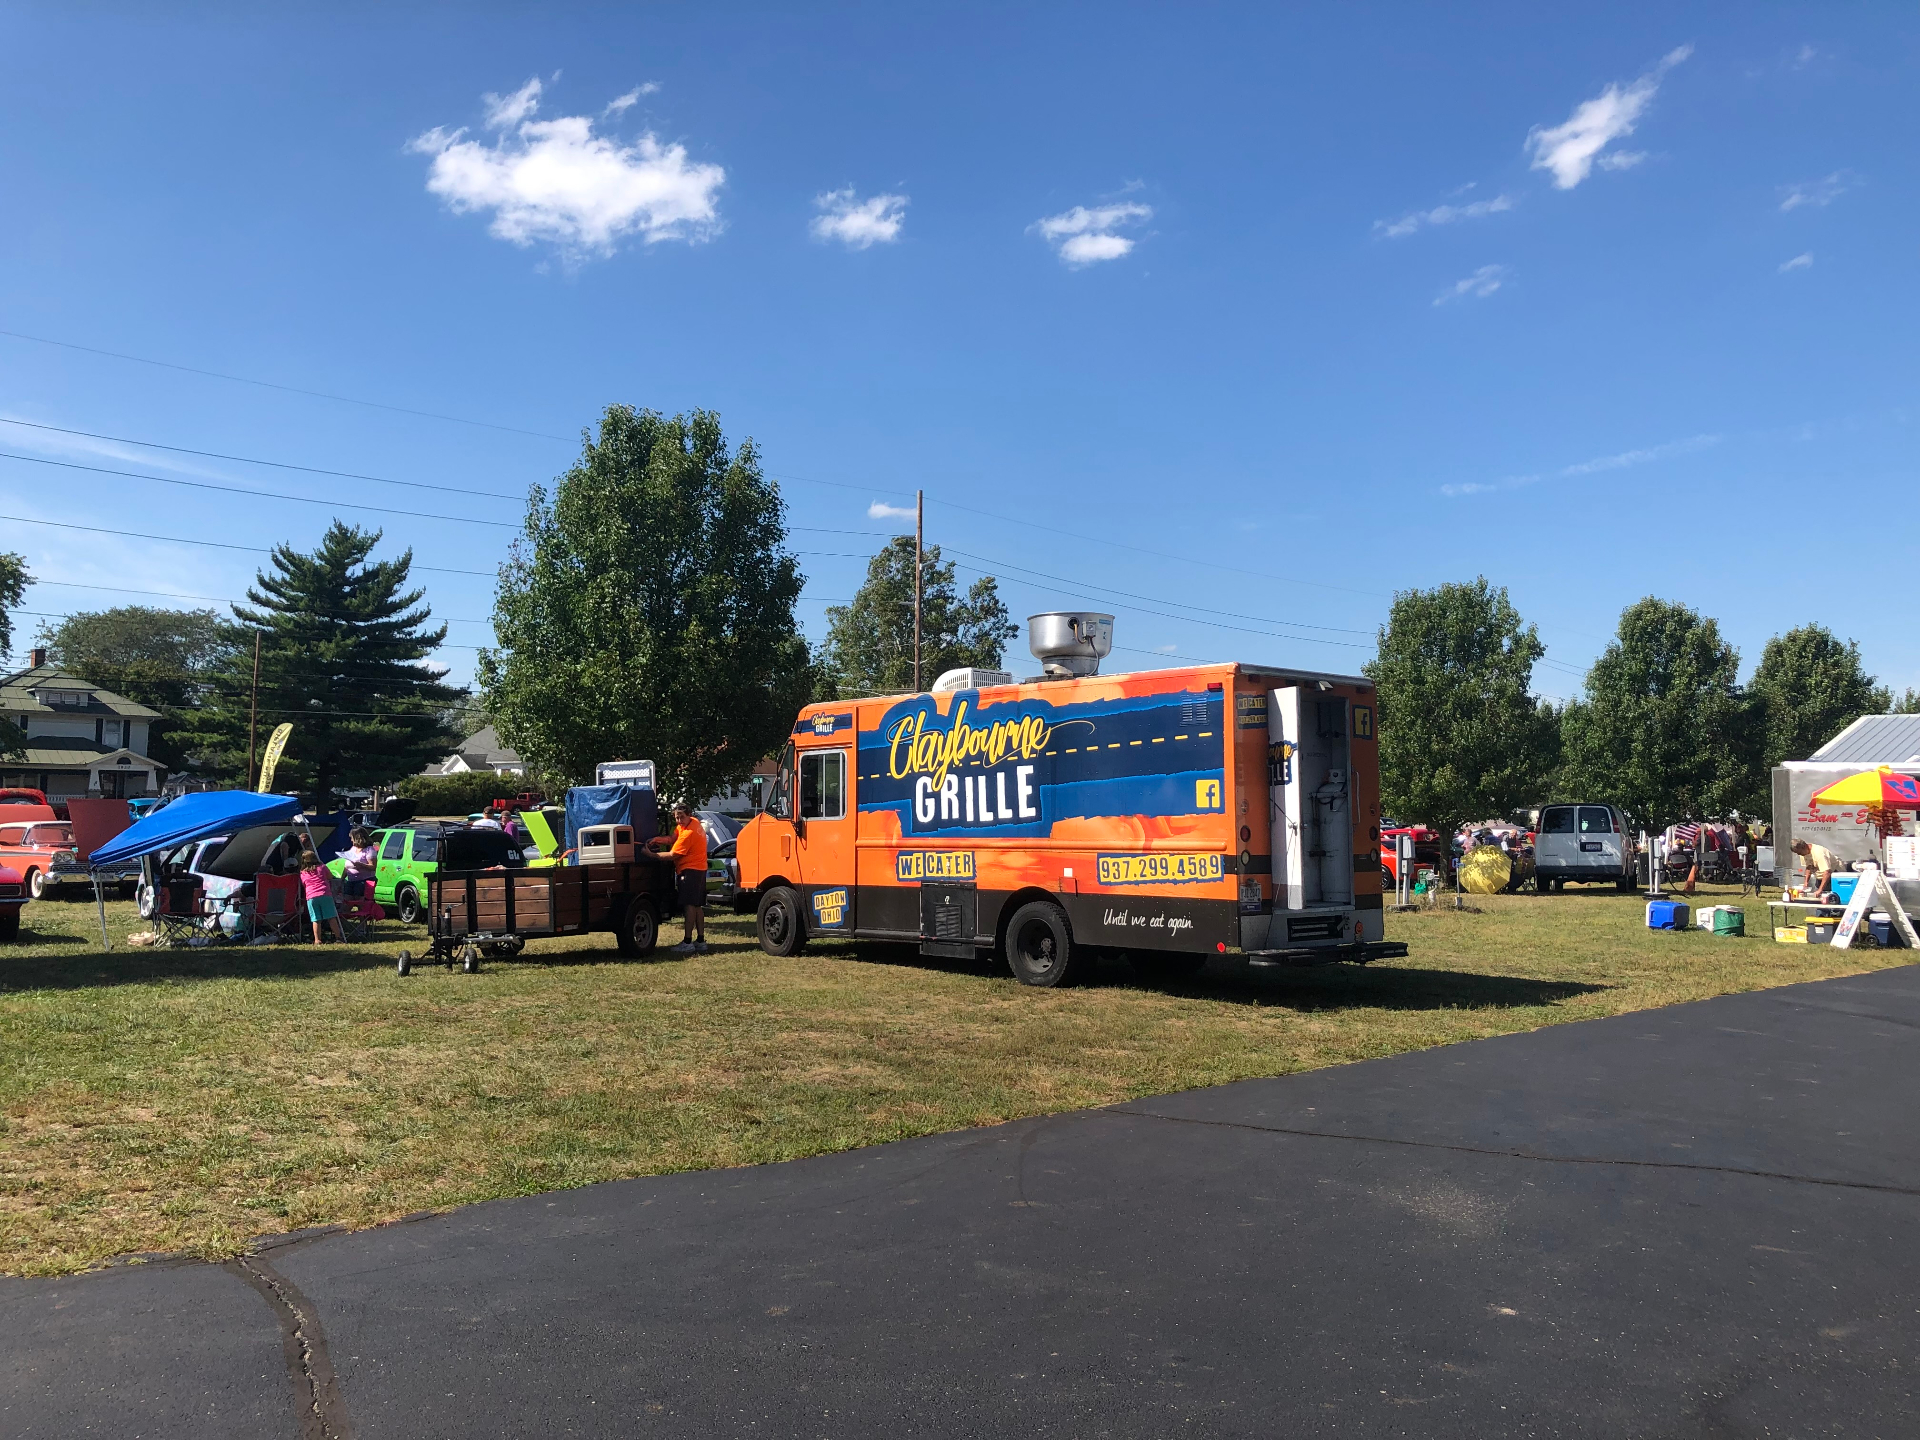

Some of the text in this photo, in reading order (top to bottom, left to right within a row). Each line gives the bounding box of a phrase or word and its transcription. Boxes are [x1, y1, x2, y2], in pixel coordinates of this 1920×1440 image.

[815, 724, 833, 733] GRILLE
[887, 699, 1056, 792] Claybourne
[915, 764, 1037, 823] GRILLE
[1808, 808, 1839, 824] Sam
[901, 853, 971, 876] WE CATER
[1101, 854, 1220, 880] 937.299.4589
[815, 892, 845, 907] DAYTON
[822, 908, 841, 922] OHIO
[1103, 908, 1128, 927] Until
[1131, 916, 1146, 927] we
[1149, 913, 1165, 928] eat
